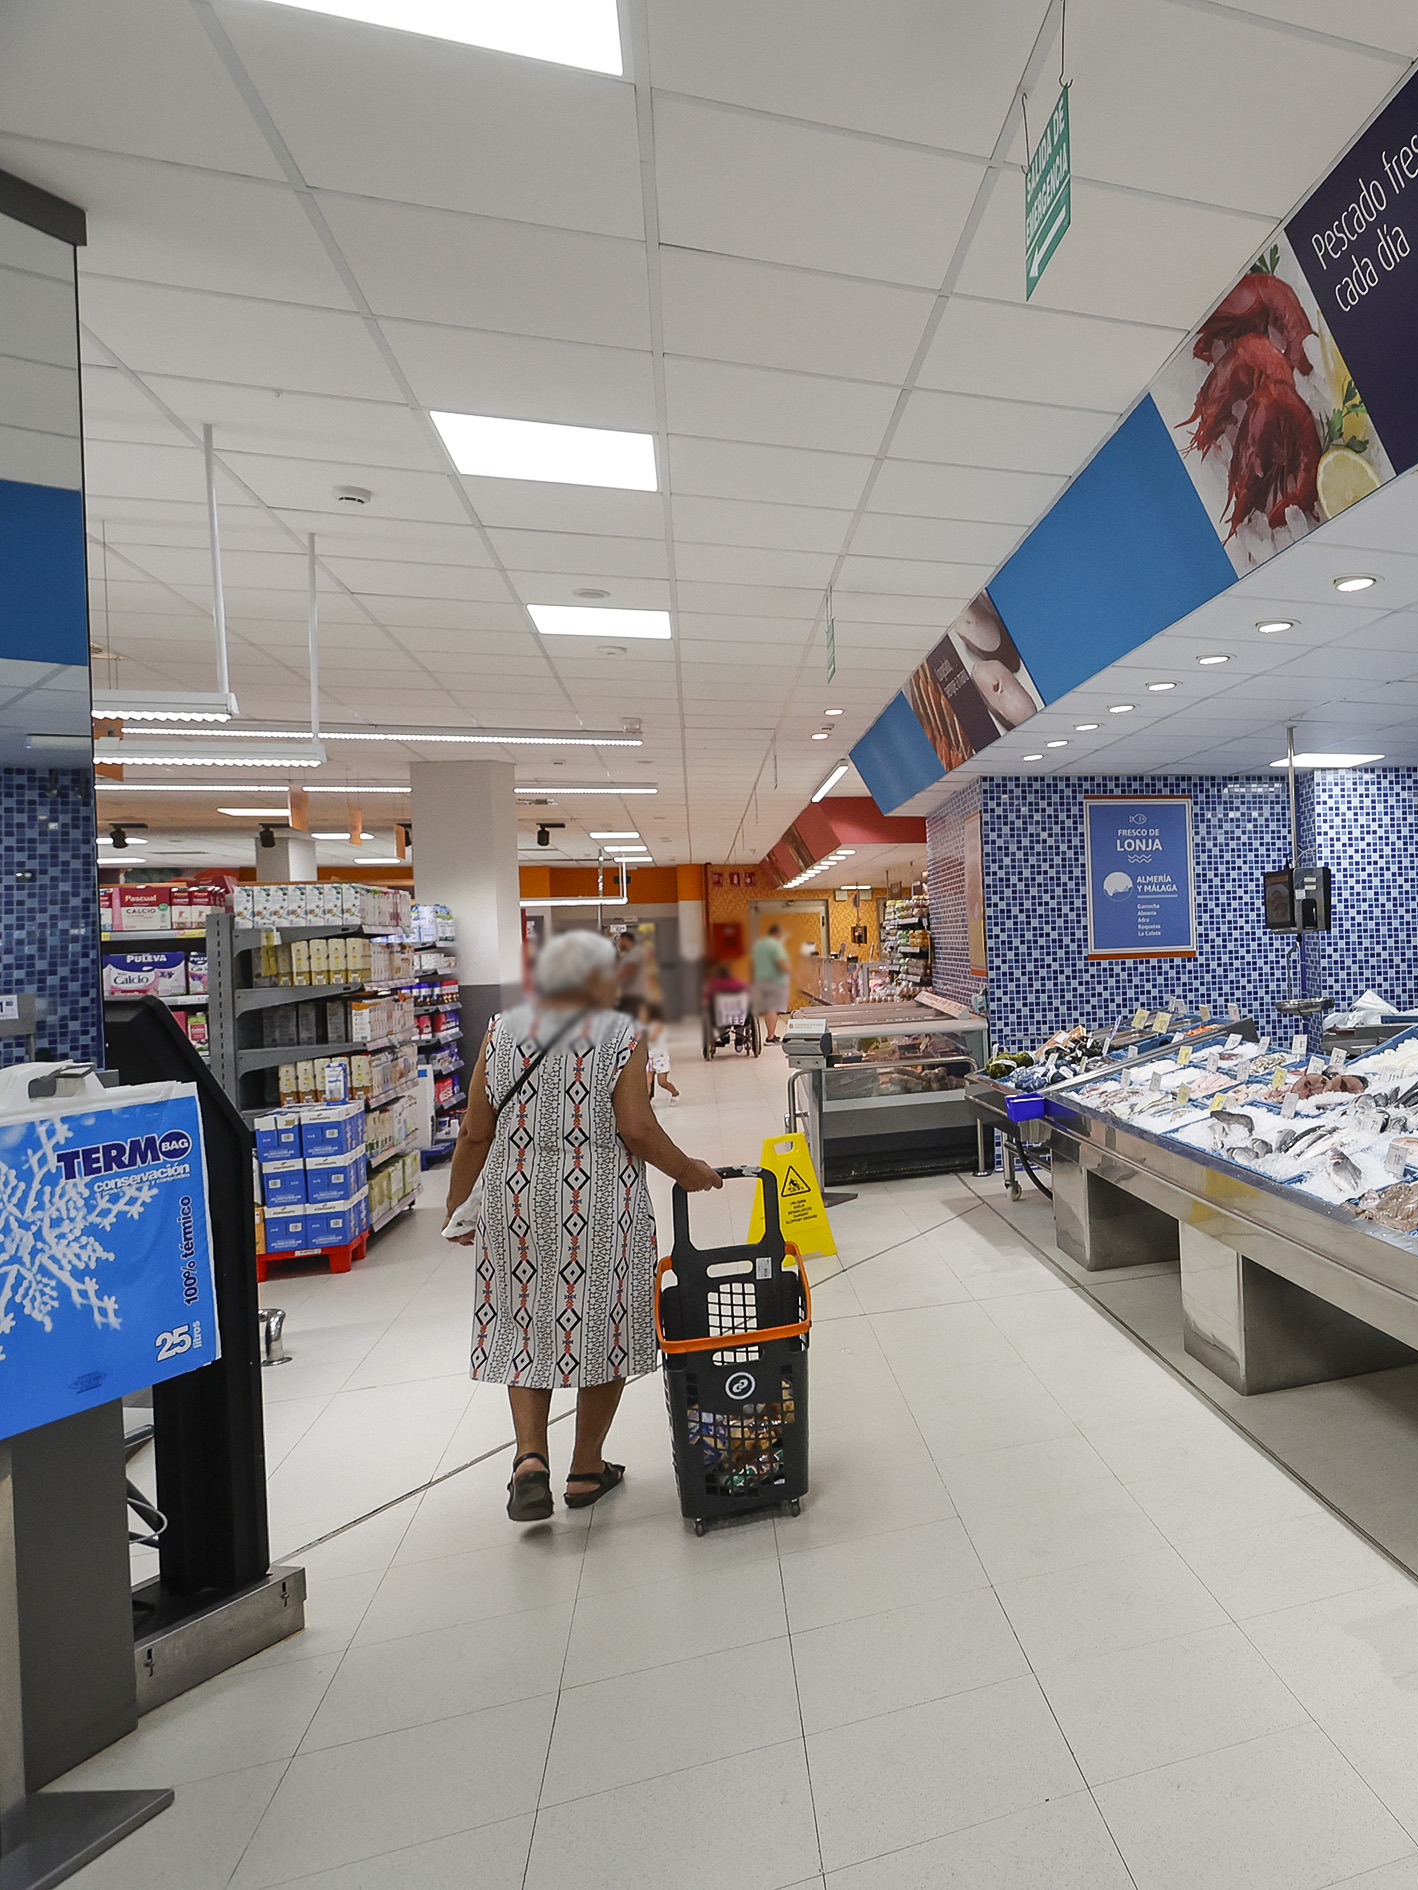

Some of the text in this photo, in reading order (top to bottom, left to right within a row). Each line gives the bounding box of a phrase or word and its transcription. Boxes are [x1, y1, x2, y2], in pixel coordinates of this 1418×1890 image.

[1027, 97, 1064, 201] SALIDA DE
[1026, 143, 1068, 247] EMERGENCIA
[1312, 178, 1387, 270] Pescado
[1335, 224, 1410, 312] cada día
[1117, 839, 1162, 851] LONJA
[1137, 873, 1172, 883] ALMERÍA
[1144, 883, 1178, 892] MÁLAGA
[126, 954, 167, 963] PULEVA
[114, 975, 149, 985] Calcio
[162, 1138, 189, 1151] BAG
[94, 1163, 190, 1192] conservación
[177, 1197, 194, 1258] térmico
[184, 1260, 199, 1305] 100%
[155, 1324, 191, 1362] 25
[193, 1321, 201, 1348] litros
